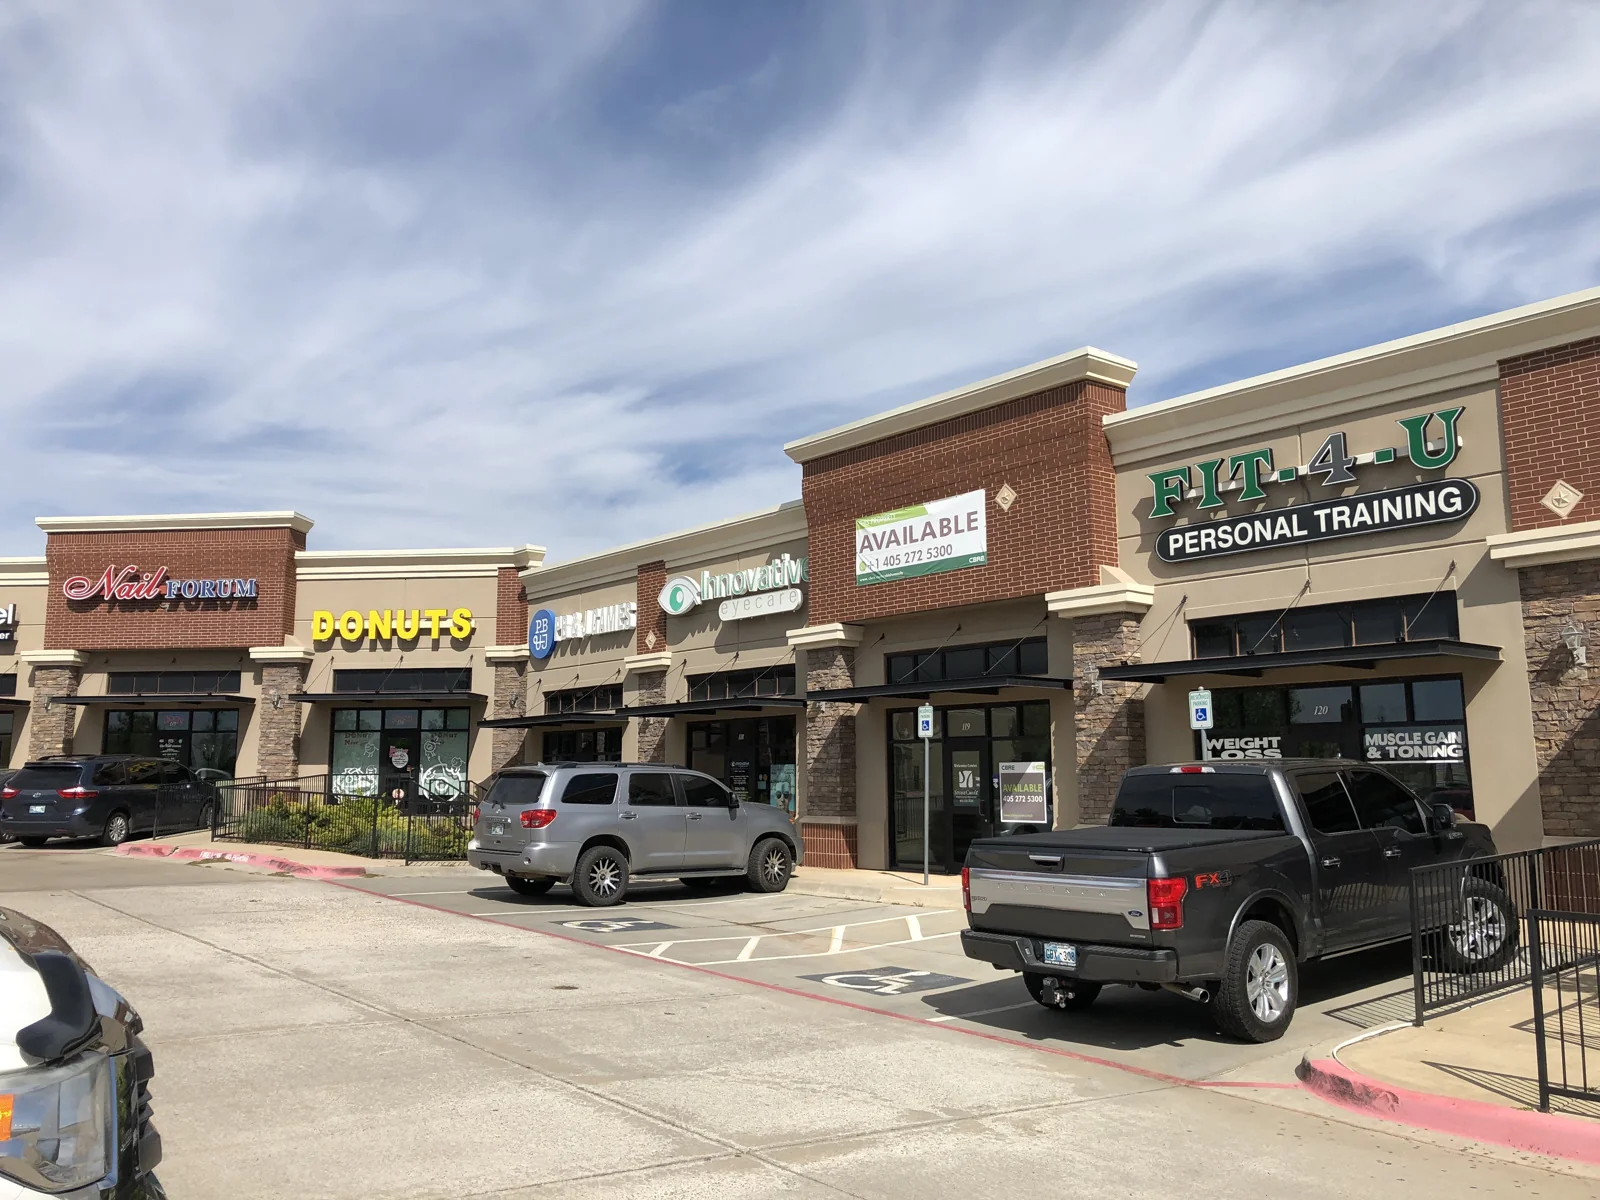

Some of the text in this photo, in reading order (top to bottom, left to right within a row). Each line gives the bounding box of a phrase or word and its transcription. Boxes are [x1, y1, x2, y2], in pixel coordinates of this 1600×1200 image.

[1168, 486, 1462, 556] PERSONAL TRAINING
[859, 510, 979, 554] AVAILABLE
[883, 553, 901, 568] 405
[904, 550, 923, 564] 272
[926, 544, 953, 560] 5300
[968, 555, 985, 564] CBRE
[63, 564, 258, 601] Nail FORUM
[700, 553, 810, 601] Innovative
[720, 591, 798, 617] eyecare
[312, 608, 473, 641] DONUTS
[535, 618, 549, 634] PB
[591, 602, 637, 635] GAMES
[1313, 705, 1328, 716] 120
[962, 722, 971, 731] 119
[1206, 736, 1281, 750] WEIGHT
[1365, 731, 1463, 746] MUSCLE GAIN
[1207, 748, 1282, 760] LOSS
[1366, 746, 1464, 760] & TONING
[1003, 784, 1043, 793] AVAILABLE
[1003, 795, 1043, 803] 405 272 5300
[1195, 870, 1231, 889] FX4
